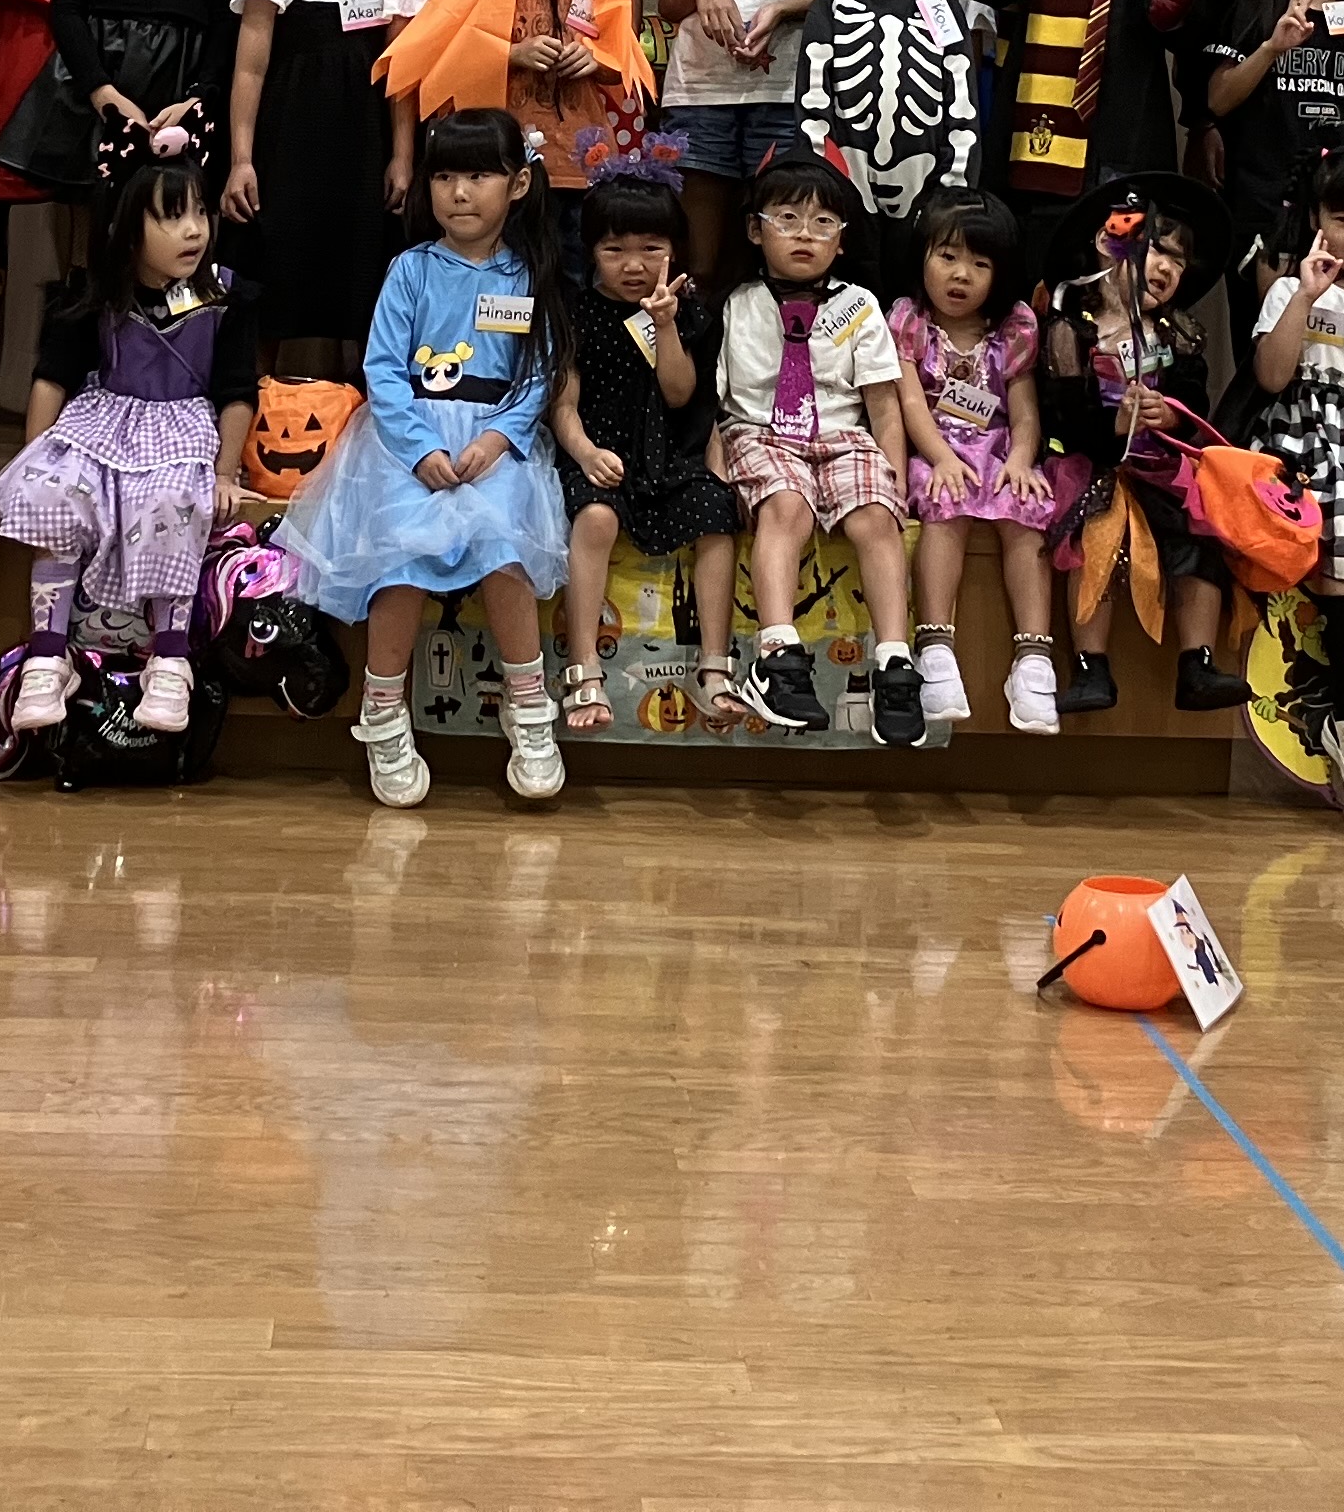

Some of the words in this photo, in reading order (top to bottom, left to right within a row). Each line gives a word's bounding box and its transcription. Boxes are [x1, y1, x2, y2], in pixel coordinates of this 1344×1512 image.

[478, 305, 532, 322] Hinano
[824, 296, 866, 336] Hajime
[942, 389, 992, 418] Azuki
